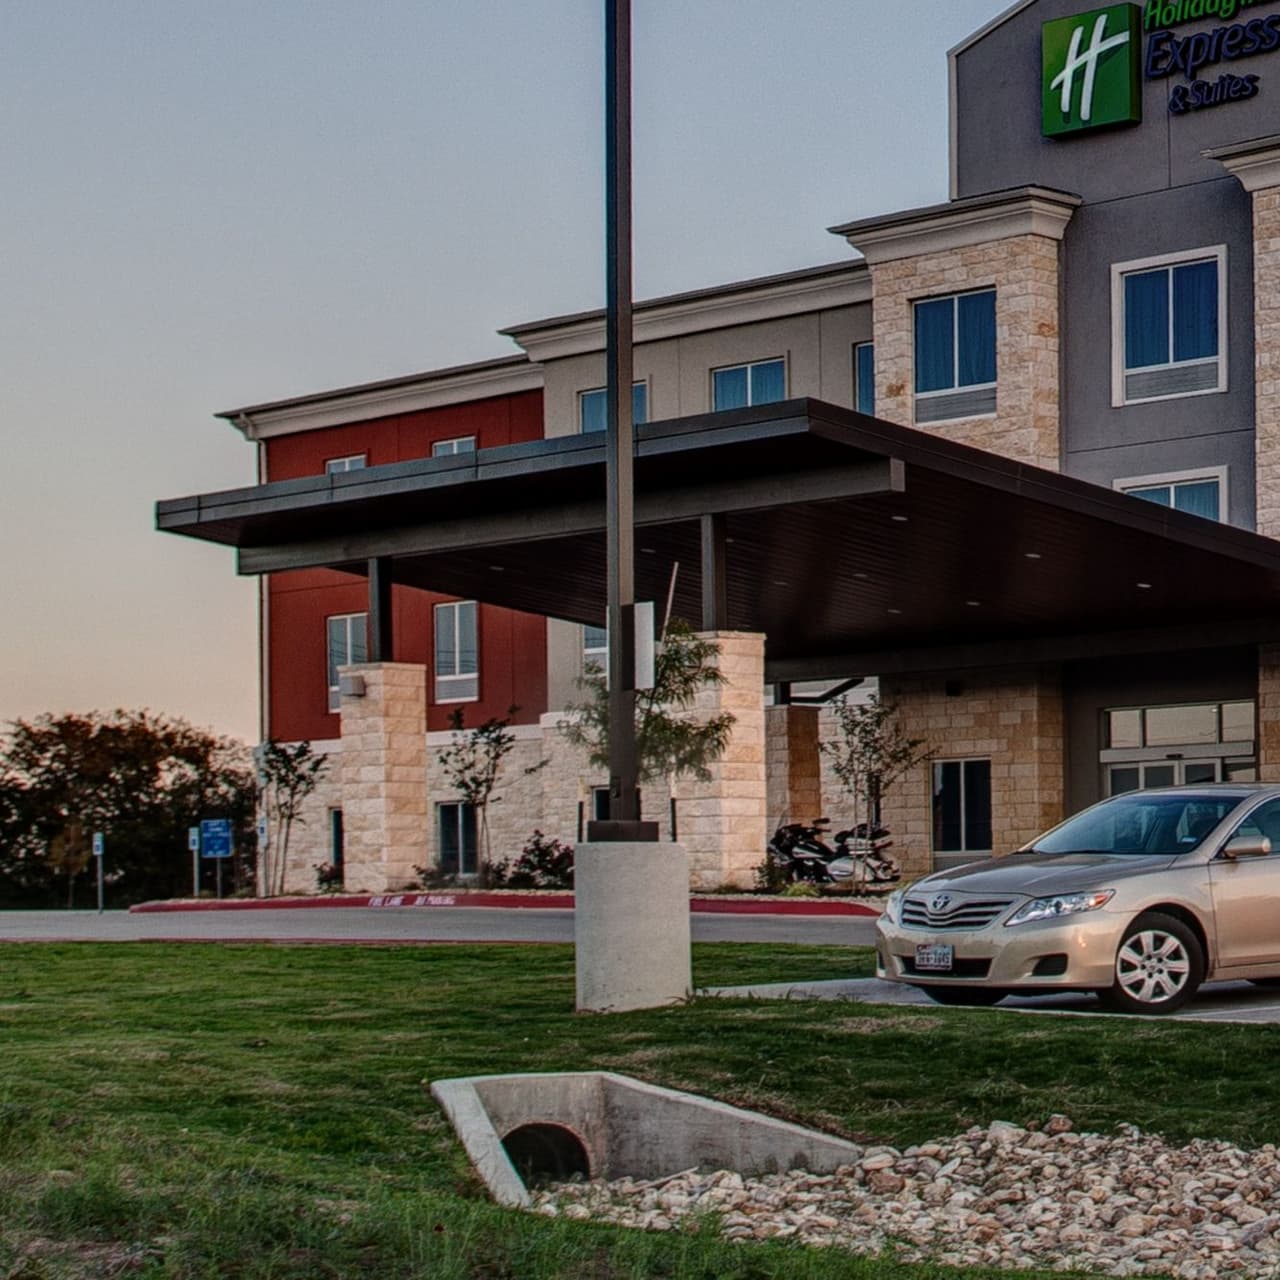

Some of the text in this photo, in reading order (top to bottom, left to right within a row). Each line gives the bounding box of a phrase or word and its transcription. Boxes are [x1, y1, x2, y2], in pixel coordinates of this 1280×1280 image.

[1050, 14, 1130, 121] H
[1168, 73, 1260, 115] & Suites
